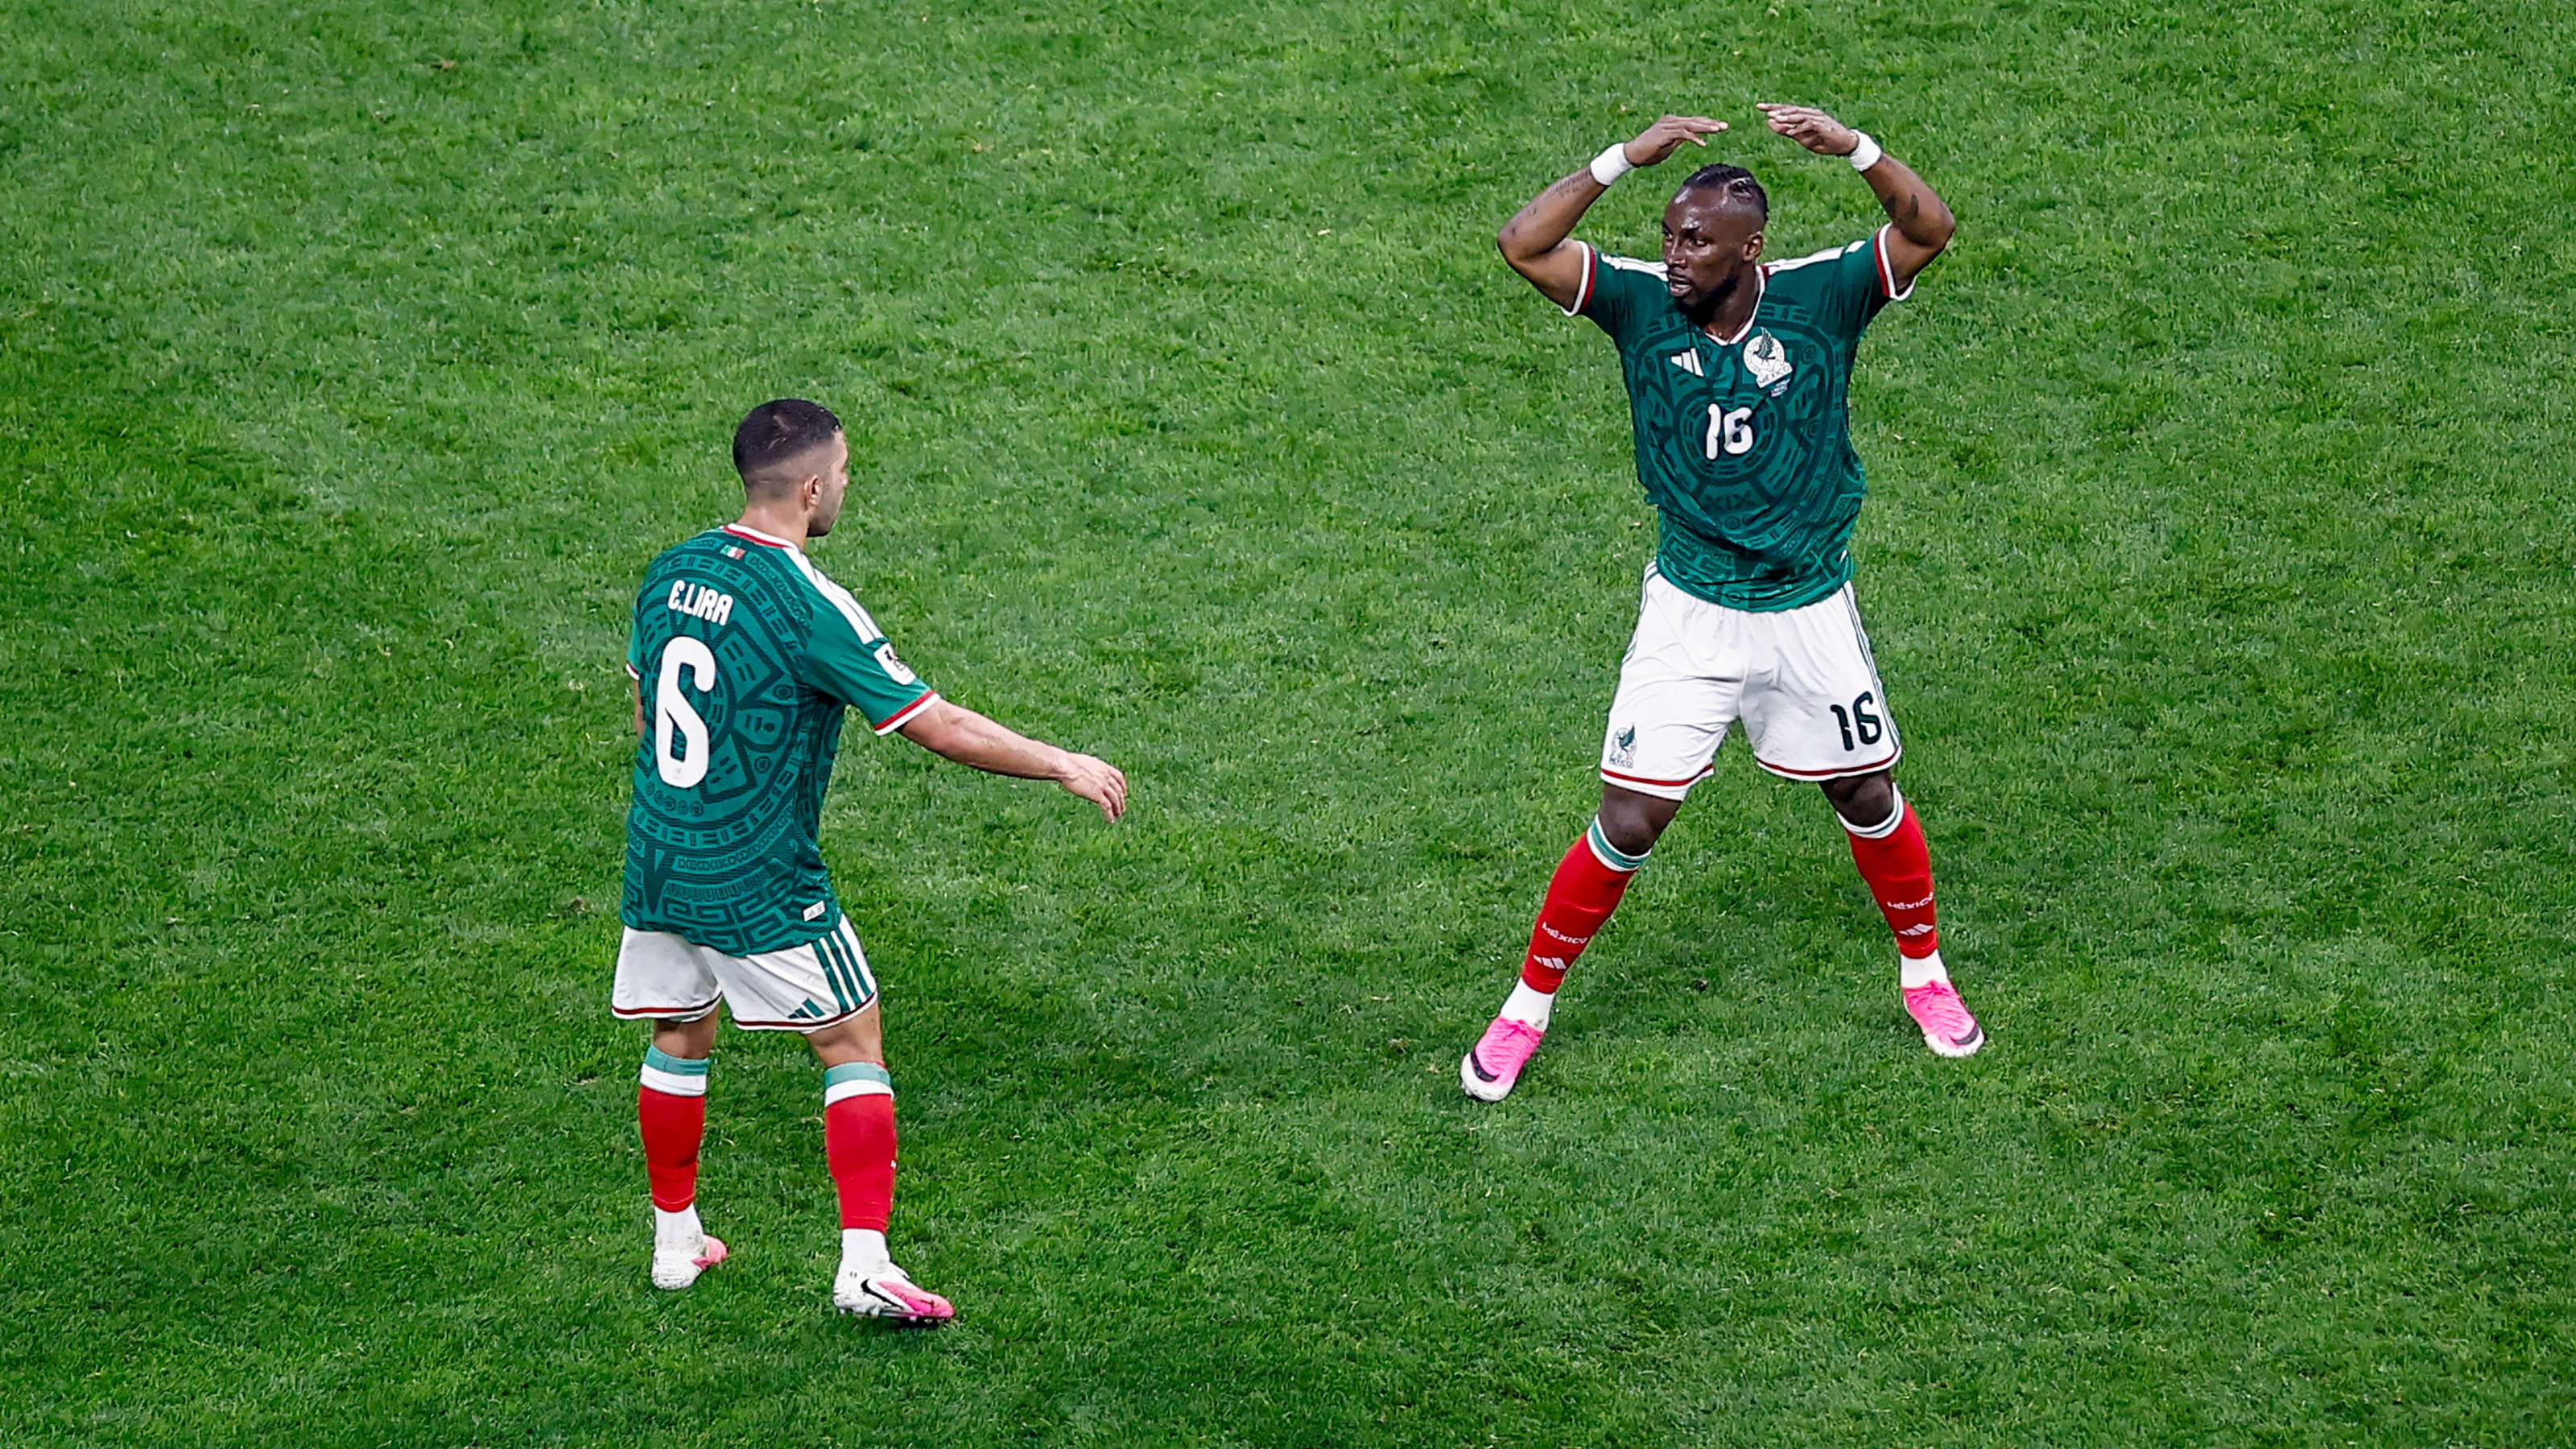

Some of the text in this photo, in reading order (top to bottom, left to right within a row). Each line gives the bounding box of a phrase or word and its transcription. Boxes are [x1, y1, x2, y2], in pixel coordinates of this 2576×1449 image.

[1706, 403, 1753, 460] 16
[667, 580, 733, 626] E.LIRA
[654, 636, 716, 788] 6
[1830, 691, 1882, 751] 16
